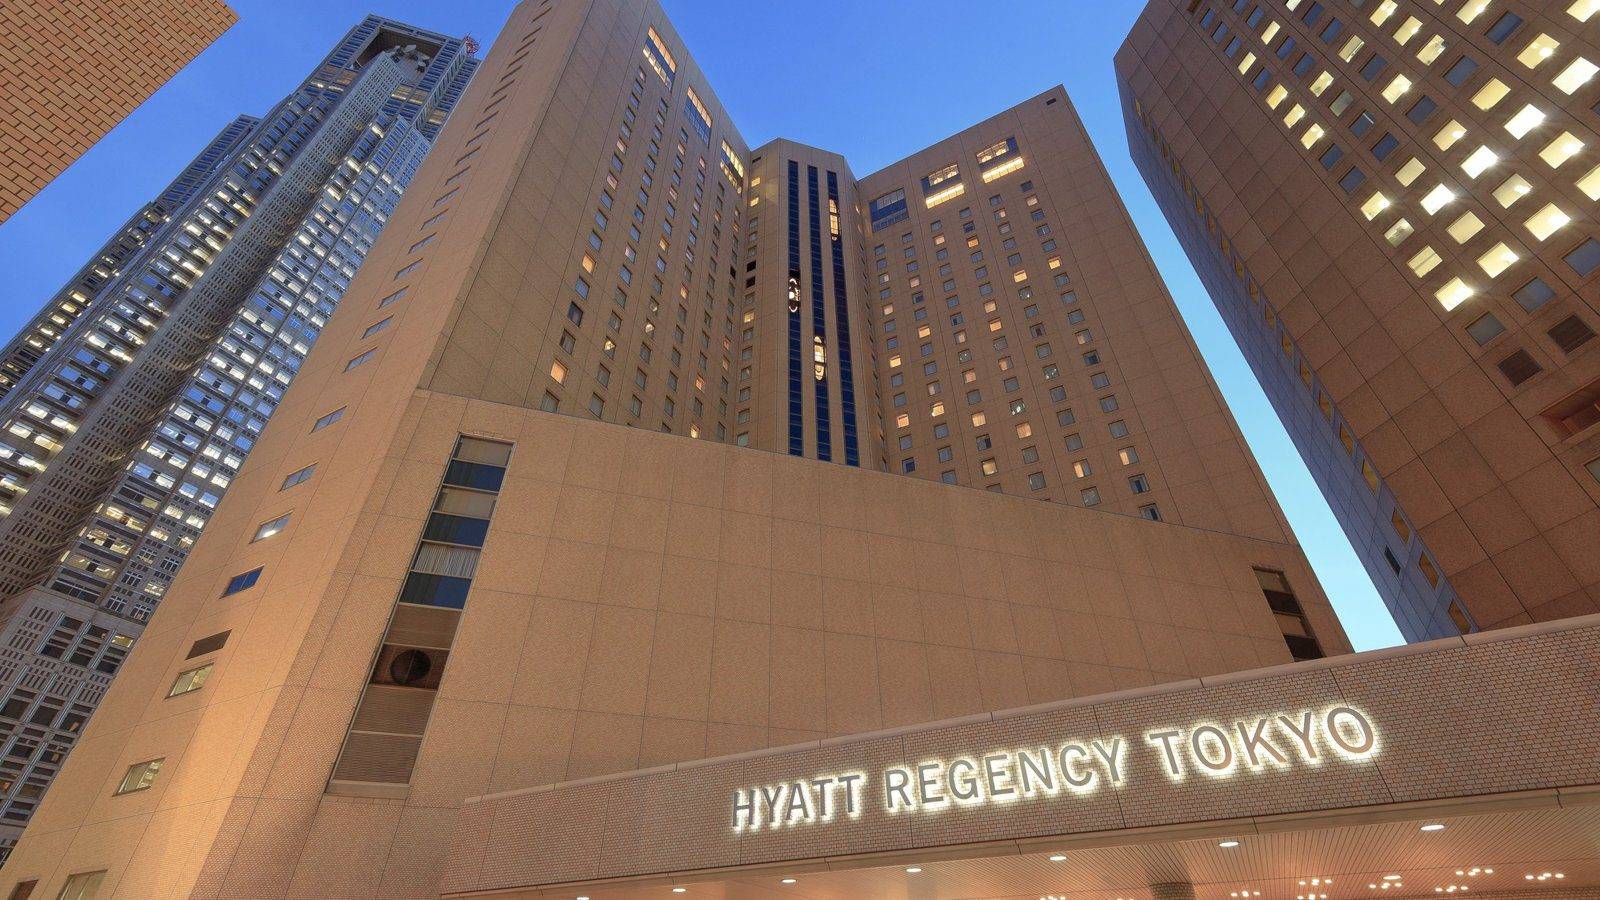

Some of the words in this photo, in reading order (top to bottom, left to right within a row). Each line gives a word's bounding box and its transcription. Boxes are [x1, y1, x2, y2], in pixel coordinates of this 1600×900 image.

[733, 774, 860, 827] HYATT
[885, 738, 1120, 809] REGENCY
[1149, 706, 1375, 775] TOKYO
